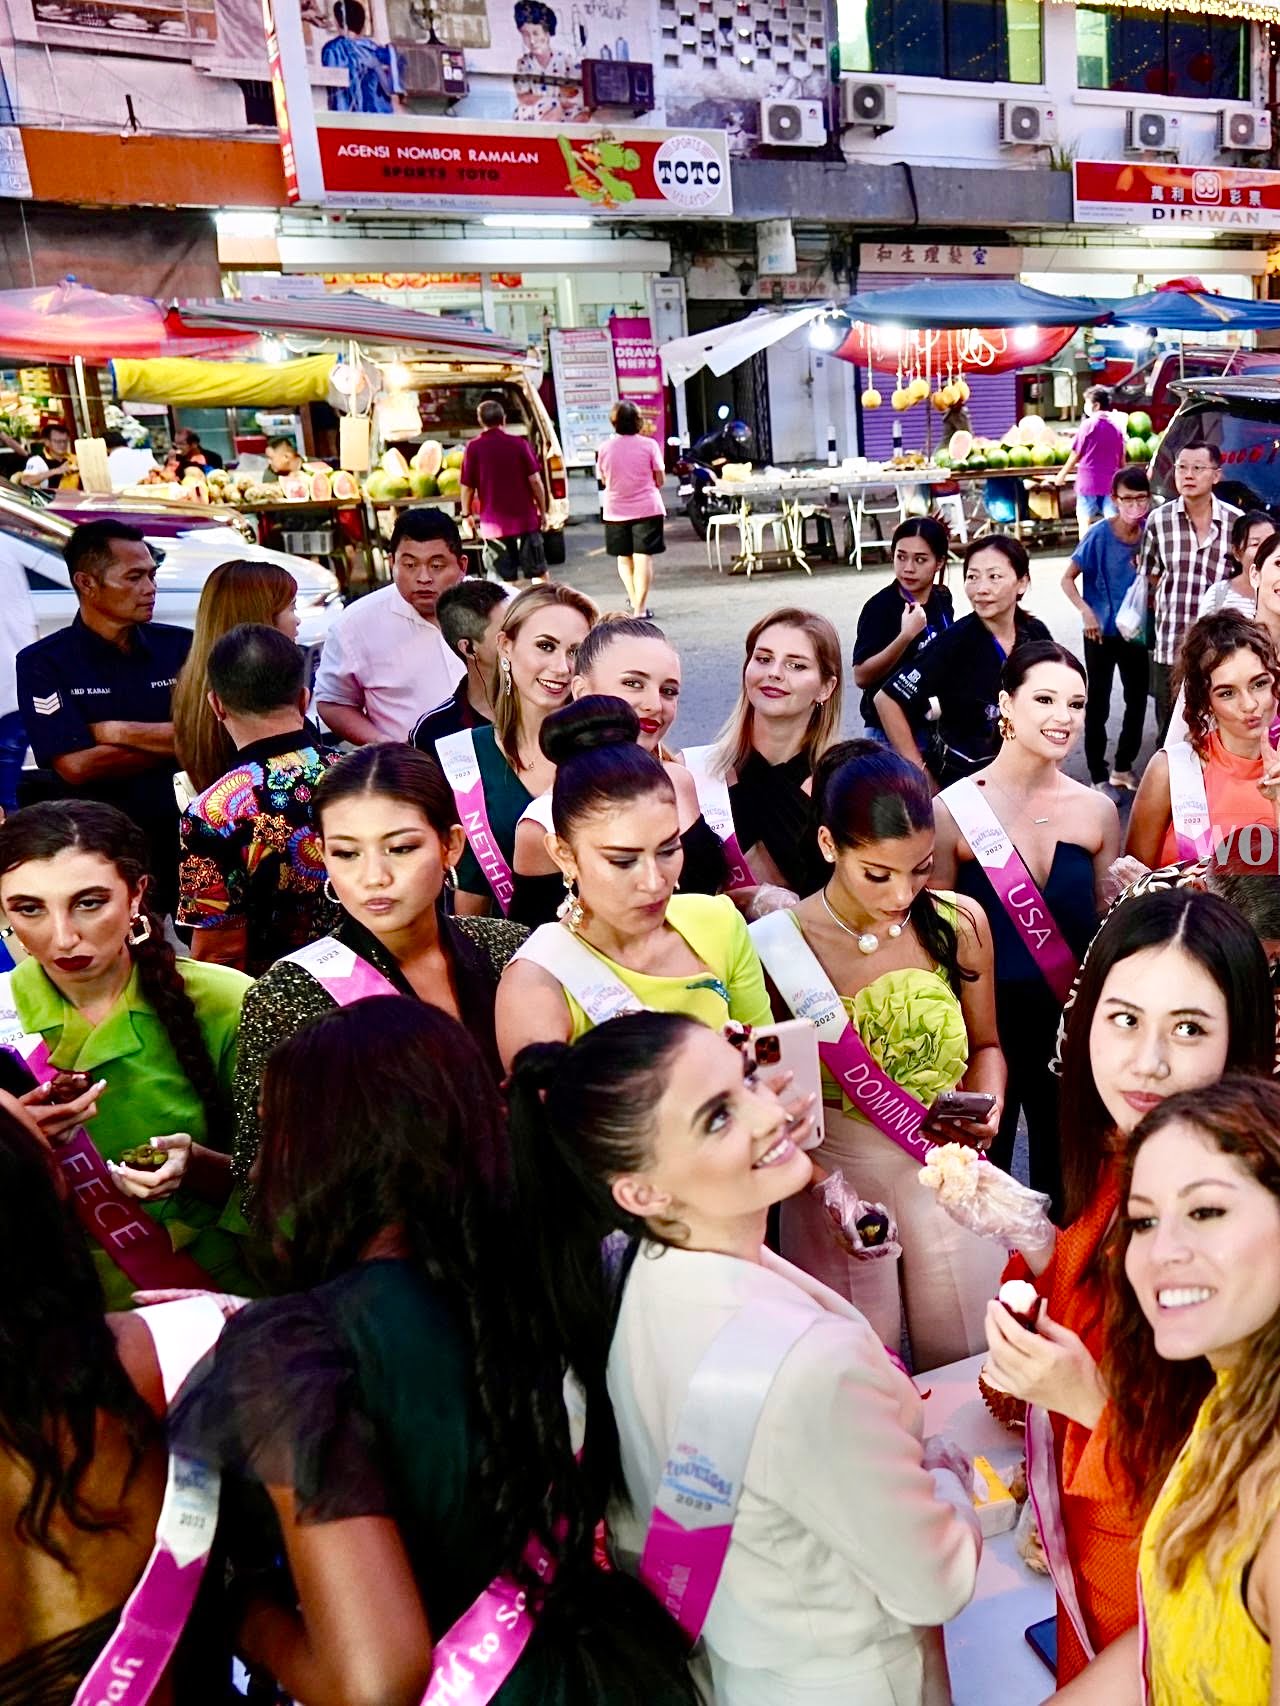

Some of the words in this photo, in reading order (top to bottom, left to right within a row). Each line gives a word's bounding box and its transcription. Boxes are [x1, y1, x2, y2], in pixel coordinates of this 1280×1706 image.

[337, 144, 390, 158] AGENSI
[397, 147, 461, 161] NOMBOR
[468, 149, 539, 164] RAMALAN
[383, 167, 446, 178] SPORTS
[457, 168, 499, 181] TOTO
[658, 161, 720, 185] TOTO
[1151, 185, 1184, 203] 萬利
[1229, 189, 1262, 206] 彩票
[1152, 207, 1261, 225] DIRIWAN
[615, 346, 657, 359] DRAW
[454, 771, 472, 780] 2023
[1183, 817, 1202, 825] 2023
[984, 843, 1004, 857] 2023
[1007, 882, 1052, 950] USA
[316, 950, 340, 965] 2023
[814, 1011, 837, 1028] 2023
[675, 1493, 713, 1512] 2023
